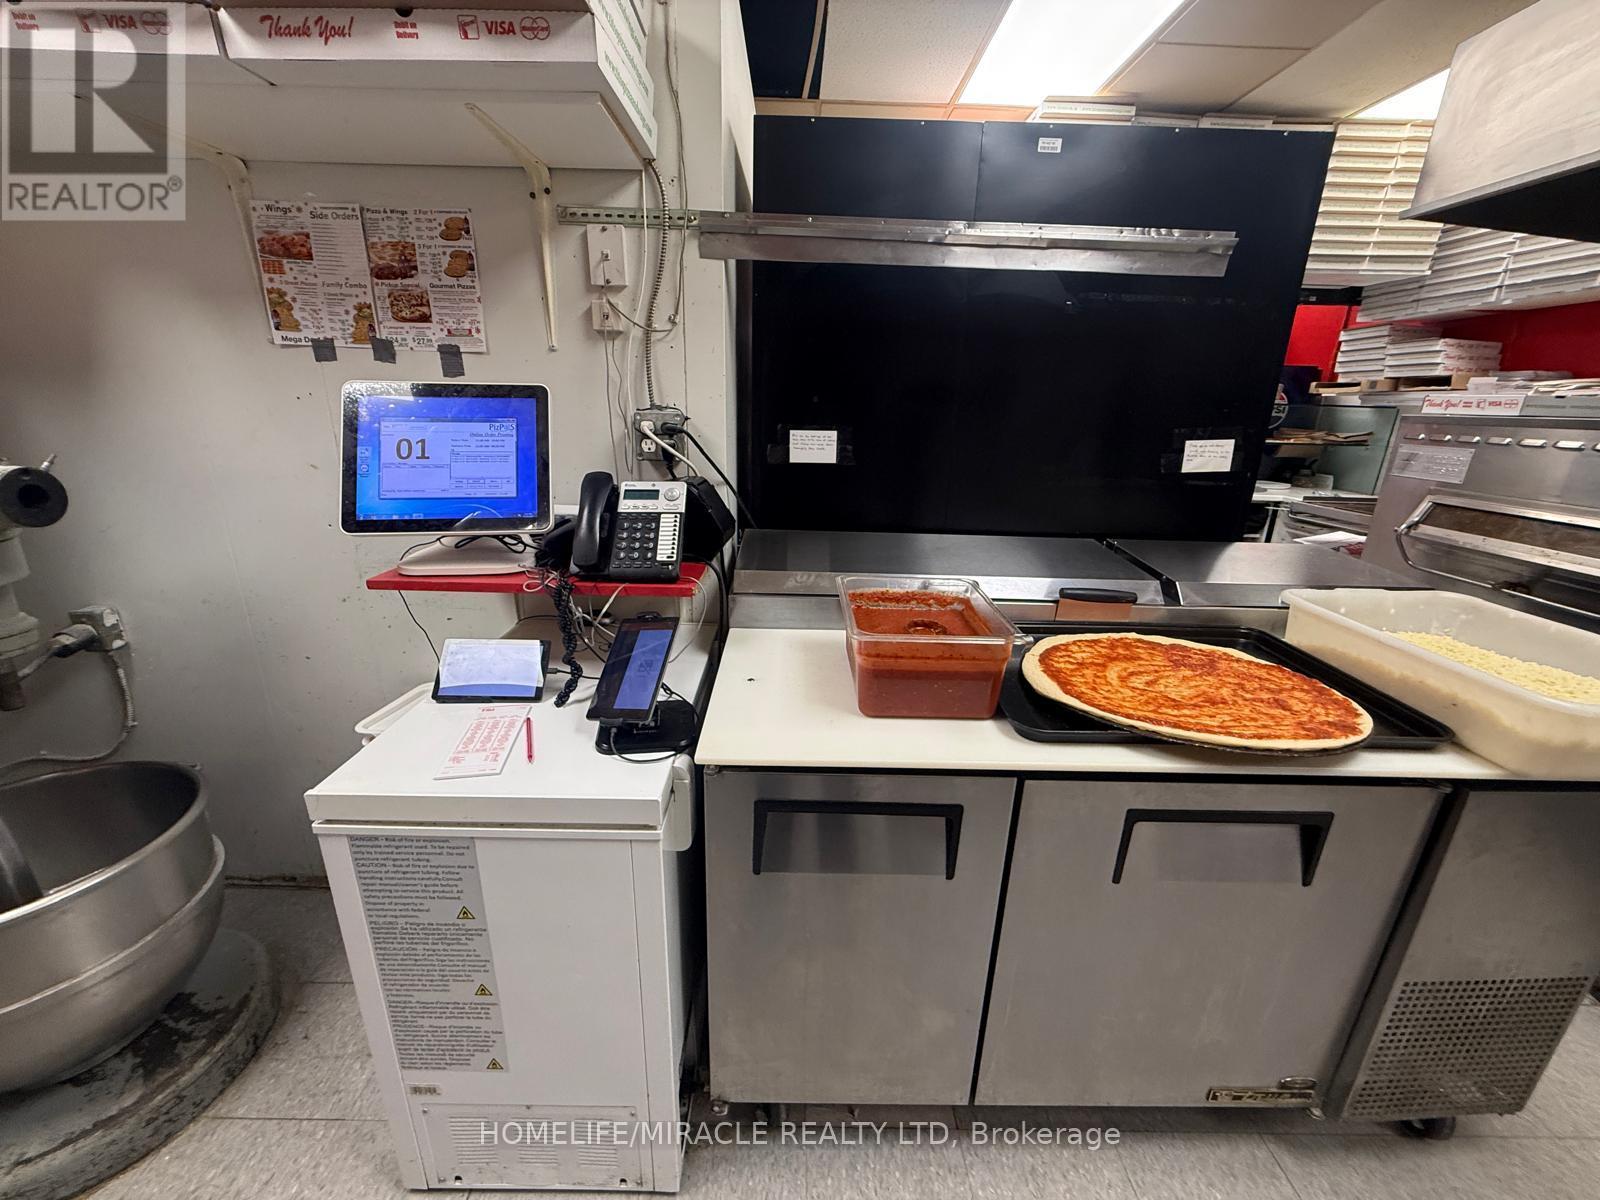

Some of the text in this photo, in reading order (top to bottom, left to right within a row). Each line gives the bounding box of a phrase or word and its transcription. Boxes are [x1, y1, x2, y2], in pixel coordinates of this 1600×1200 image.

[103, 14, 139, 30] VISA
[482, 20, 516, 36] VISA
[259, 14, 354, 46] Thank You!
[264, 203, 292, 215] Wings
[310, 210, 360, 221] Side Orders
[344, 282, 368, 290] Combo
[281, 335, 303, 344] Mega
[396, 438, 430, 460] 01
